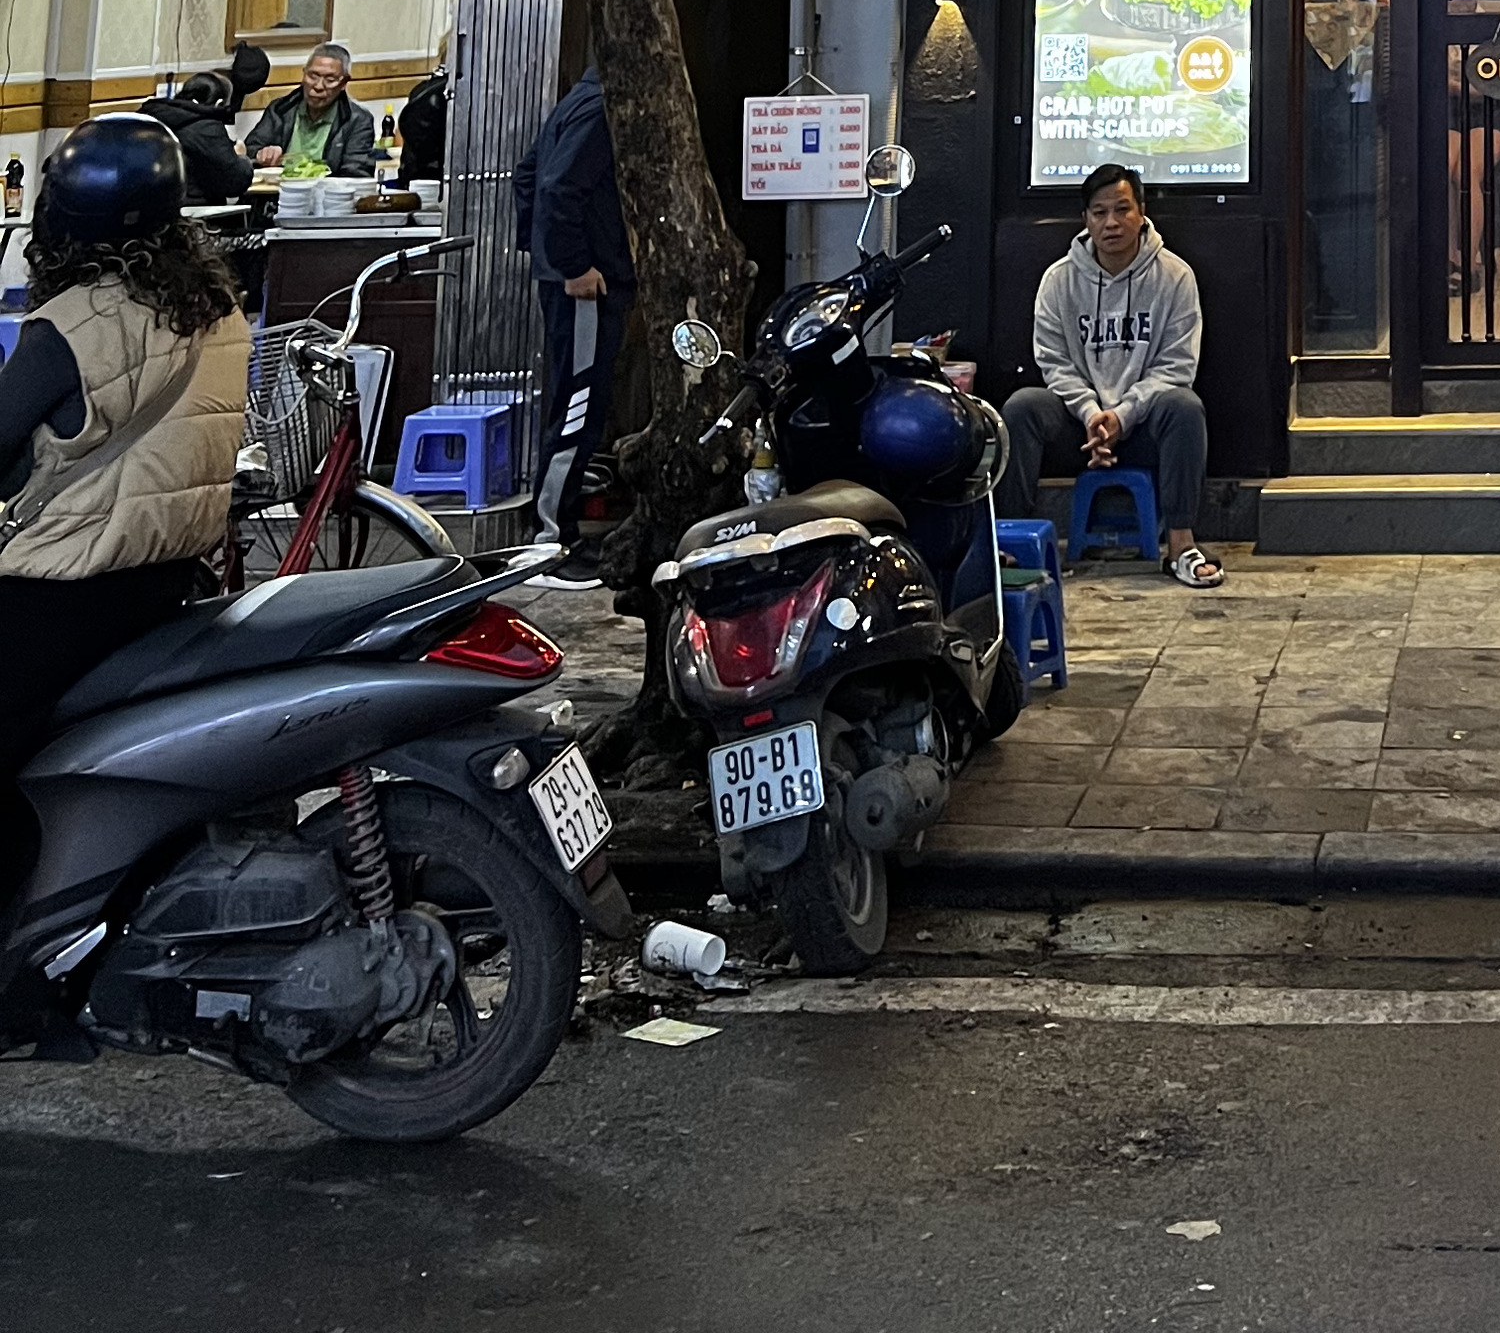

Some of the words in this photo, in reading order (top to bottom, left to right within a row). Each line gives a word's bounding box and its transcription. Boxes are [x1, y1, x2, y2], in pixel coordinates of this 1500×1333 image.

[1038, 119, 1089, 140] WITH
[1092, 117, 1190, 139] SCALLOPS
[1039, 95, 1092, 116] CRAB
[1096, 95, 1135, 116] HOT
[1138, 95, 1175, 115] POT
[714, 520, 757, 542] SYM
[724, 732, 800, 786] 90-B1
[541, 756, 588, 819] 29-C1
[719, 769, 816, 829] 879.68
[556, 792, 609, 863] 637.29
